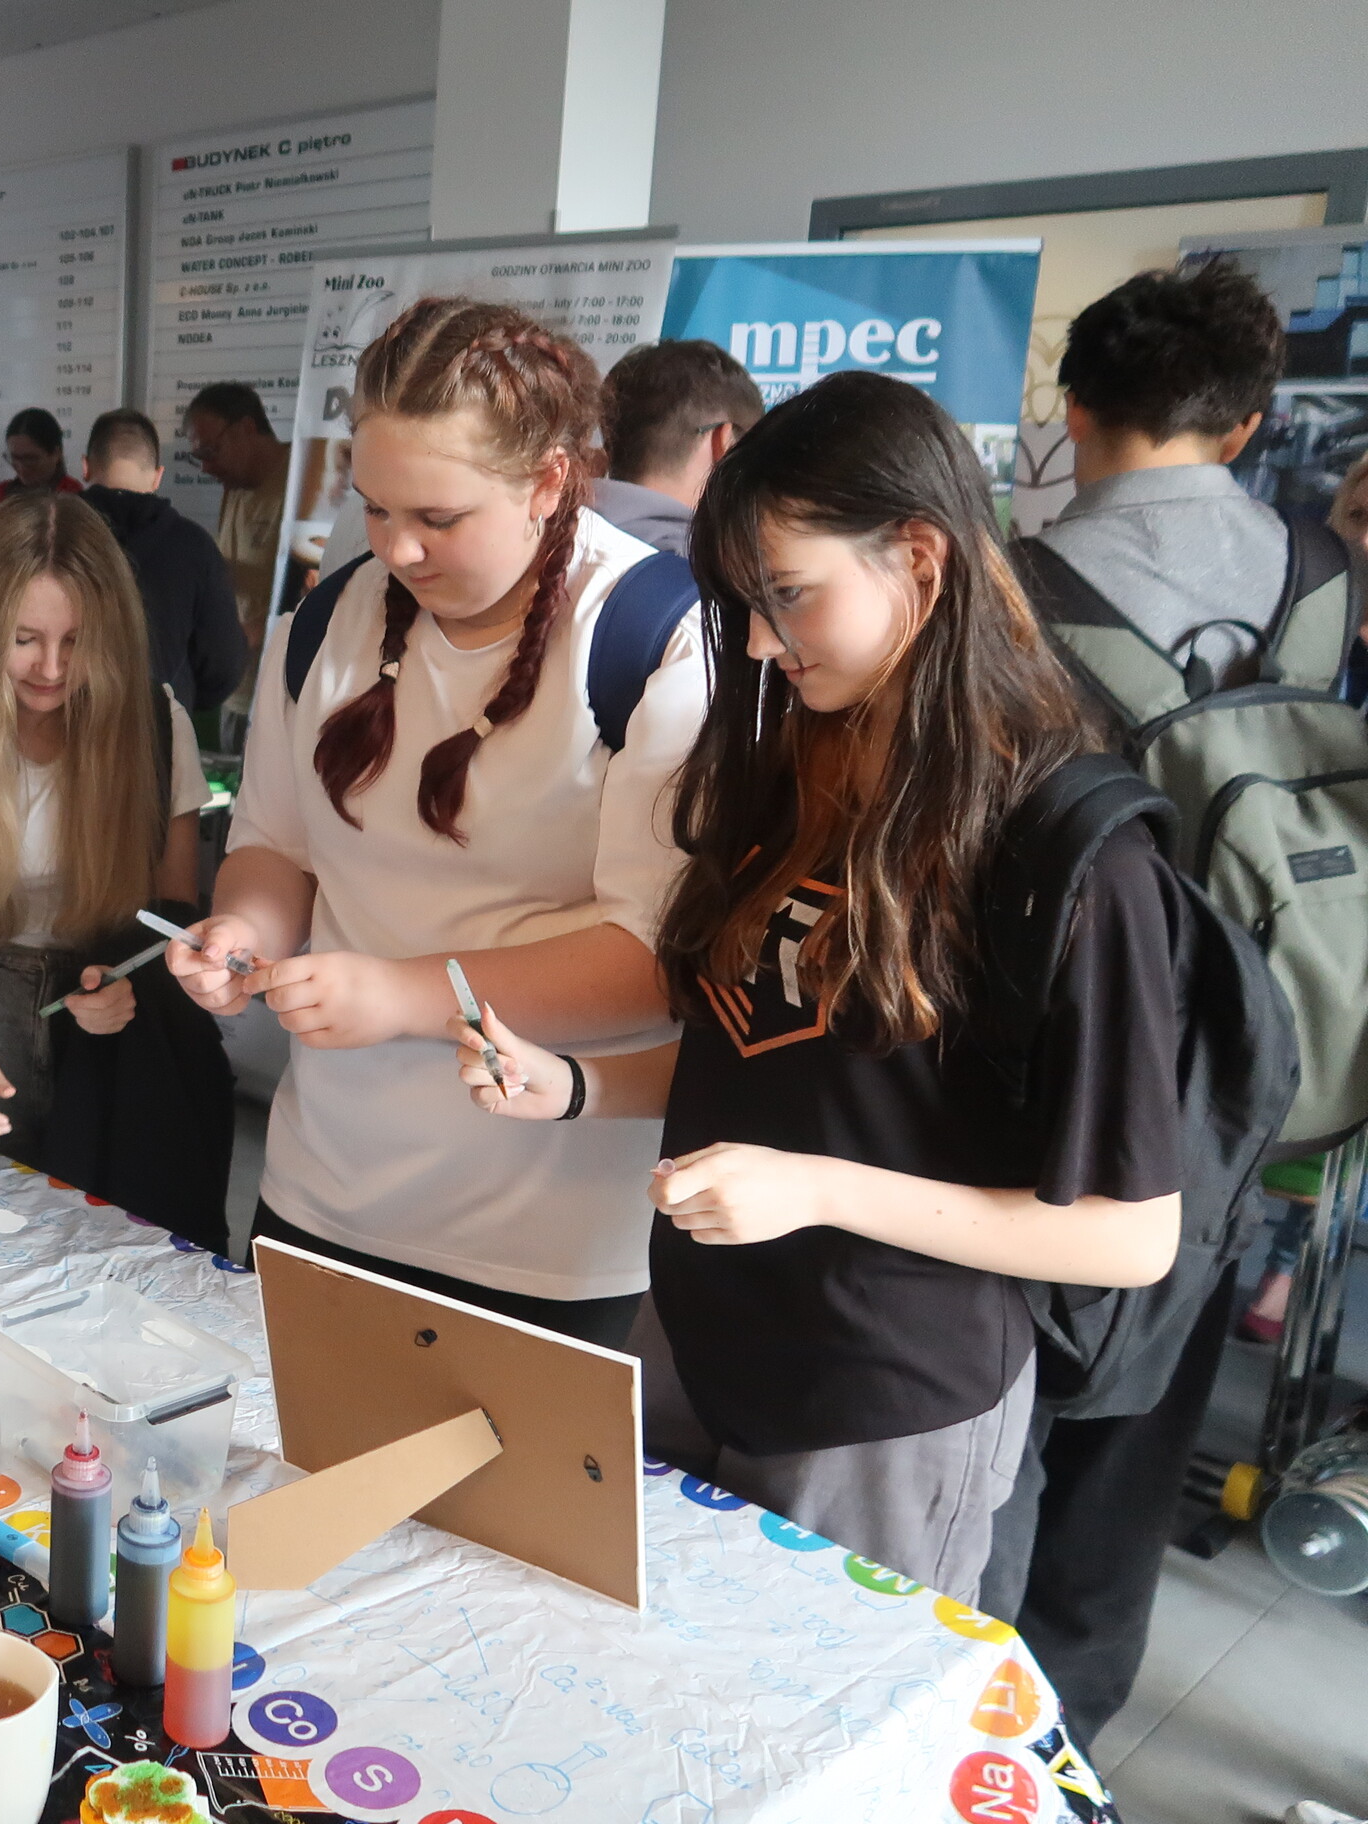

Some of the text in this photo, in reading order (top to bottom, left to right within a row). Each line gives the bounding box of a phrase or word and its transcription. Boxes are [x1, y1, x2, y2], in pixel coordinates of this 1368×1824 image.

[183, 133, 351, 169] BUDYNEK C piętro
[181, 257, 216, 273] WATER
[491, 258, 652, 278] GODZINY OTWARCIA MINI ZOO
[324, 273, 385, 293] Mini Zoo
[582, 296, 606, 308] 7:00
[604, 332, 637, 345] 20:00
[729, 317, 943, 386] mpec
[264, 1698, 318, 1741] Co
[352, 1763, 394, 1793] S
[970, 1762, 1015, 1821] Na
